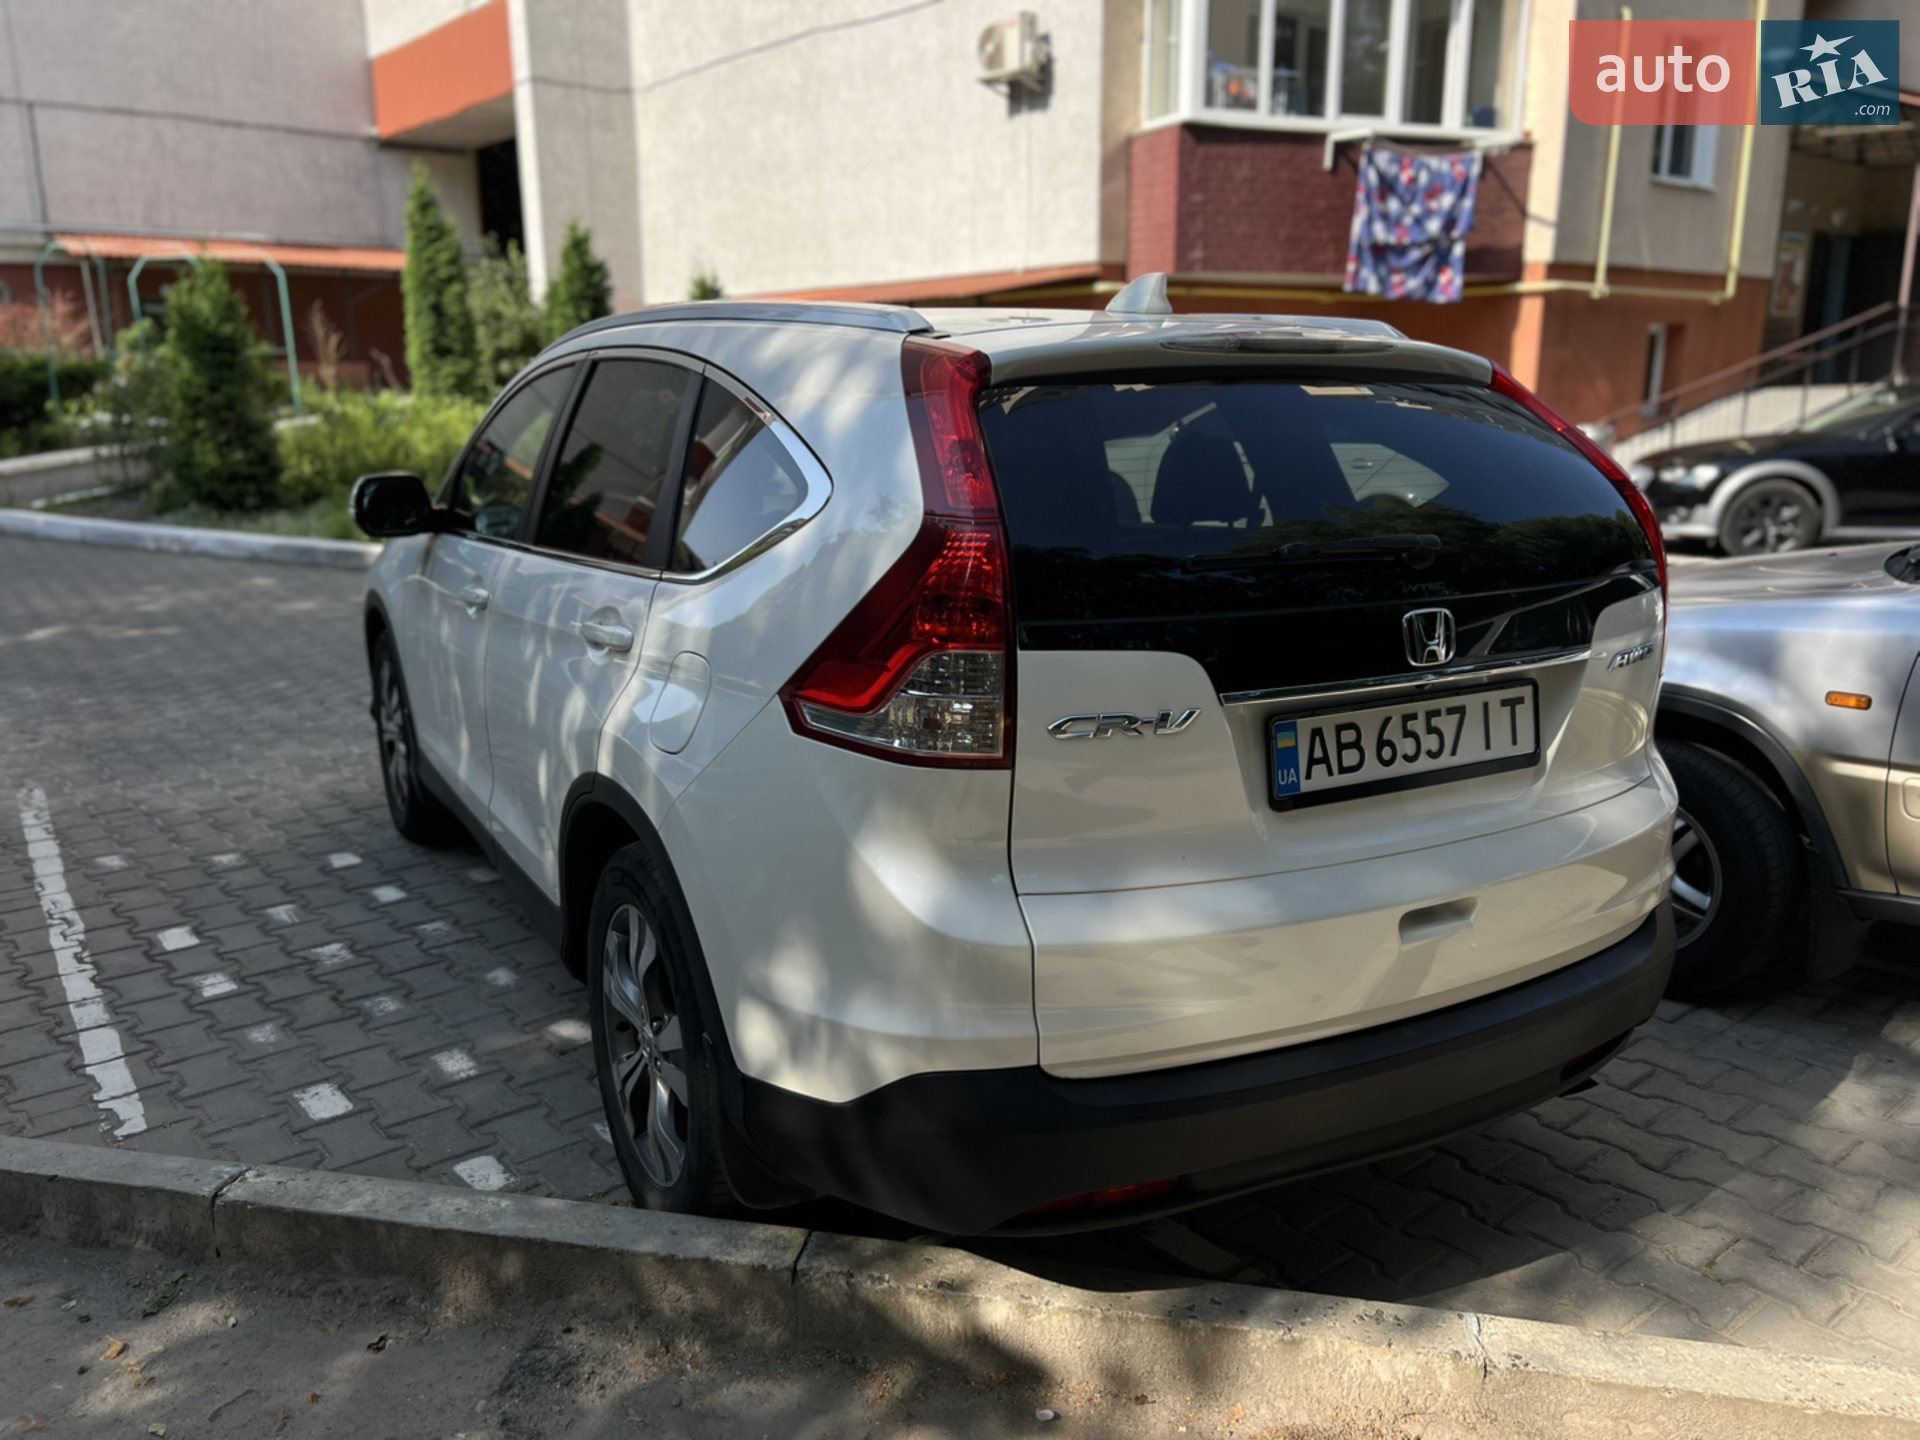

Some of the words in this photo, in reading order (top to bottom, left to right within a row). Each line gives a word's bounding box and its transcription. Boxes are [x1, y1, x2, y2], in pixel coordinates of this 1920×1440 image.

[1607, 641, 1653, 672] AWD
[1047, 707, 1201, 740] CR-V
[1304, 721, 1366, 781] AB
[1376, 706, 1466, 768] 6557
[1483, 696, 1526, 751] IT
[1277, 768, 1298, 786] UA
